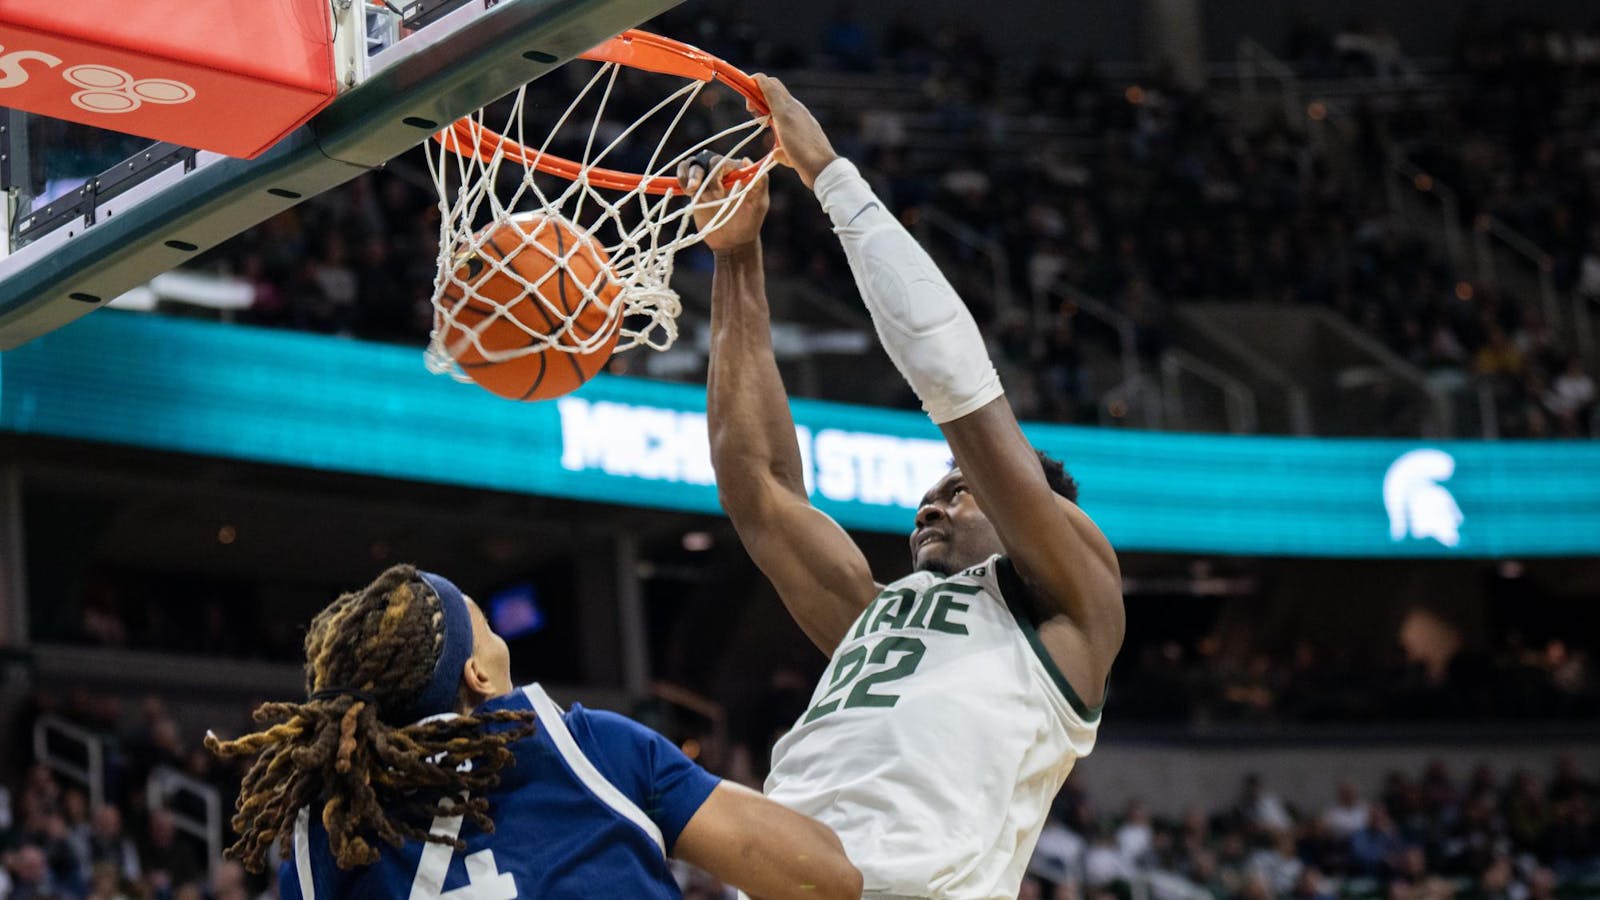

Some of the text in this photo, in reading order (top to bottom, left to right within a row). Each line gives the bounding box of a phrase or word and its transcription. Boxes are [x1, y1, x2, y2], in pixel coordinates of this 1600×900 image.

[557, 397, 813, 494] MICH
[852, 582, 984, 640] TATE
[803, 636, 927, 725] 22
[408, 789, 518, 900] 4
